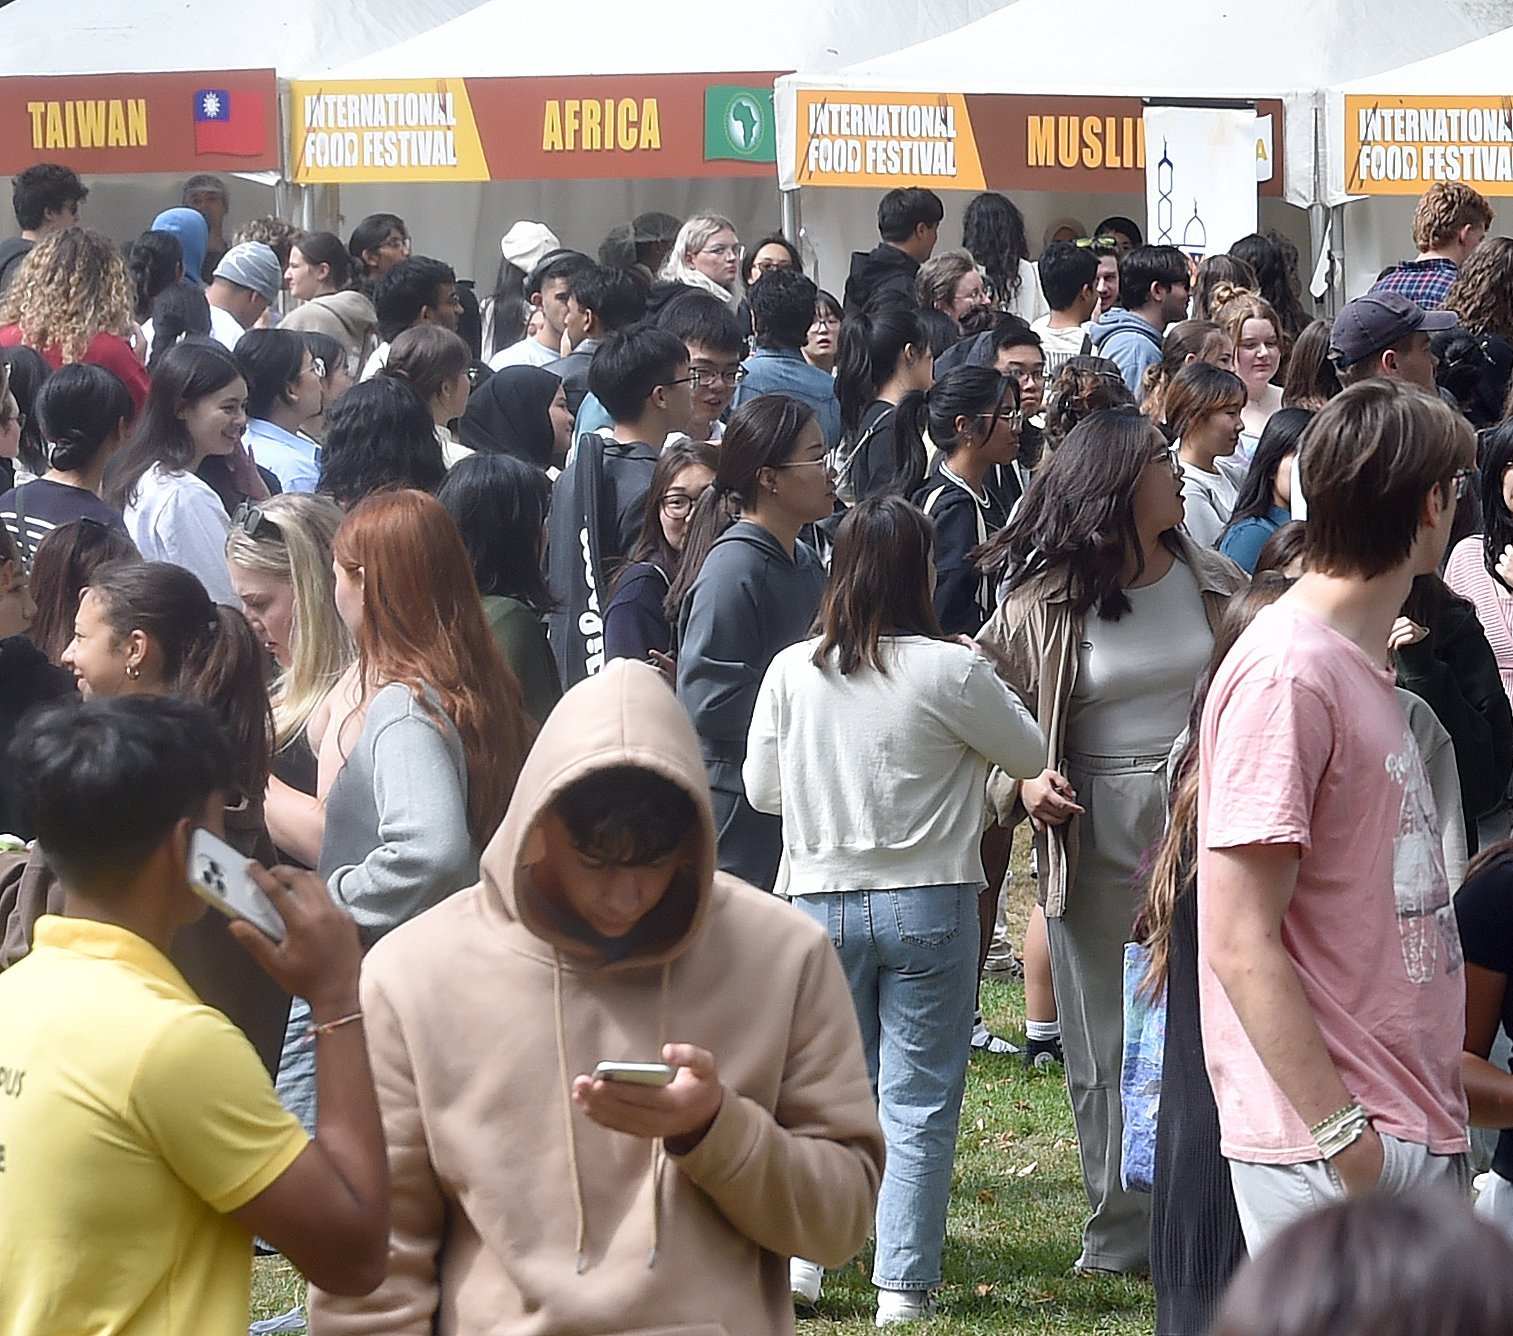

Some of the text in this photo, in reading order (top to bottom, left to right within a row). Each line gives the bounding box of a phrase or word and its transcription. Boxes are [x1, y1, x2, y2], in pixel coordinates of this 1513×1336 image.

[27, 99, 147, 149] TAIWAN
[304, 93, 456, 127] INTERNATIONAL
[543, 98, 661, 151] AFRICA
[808, 103, 957, 138] INTERNATIONAL
[304, 130, 458, 167] FOOD FESTIVAL
[808, 138, 957, 177] FOOD FESTIVAL
[1358, 145, 1418, 181] FOOD
